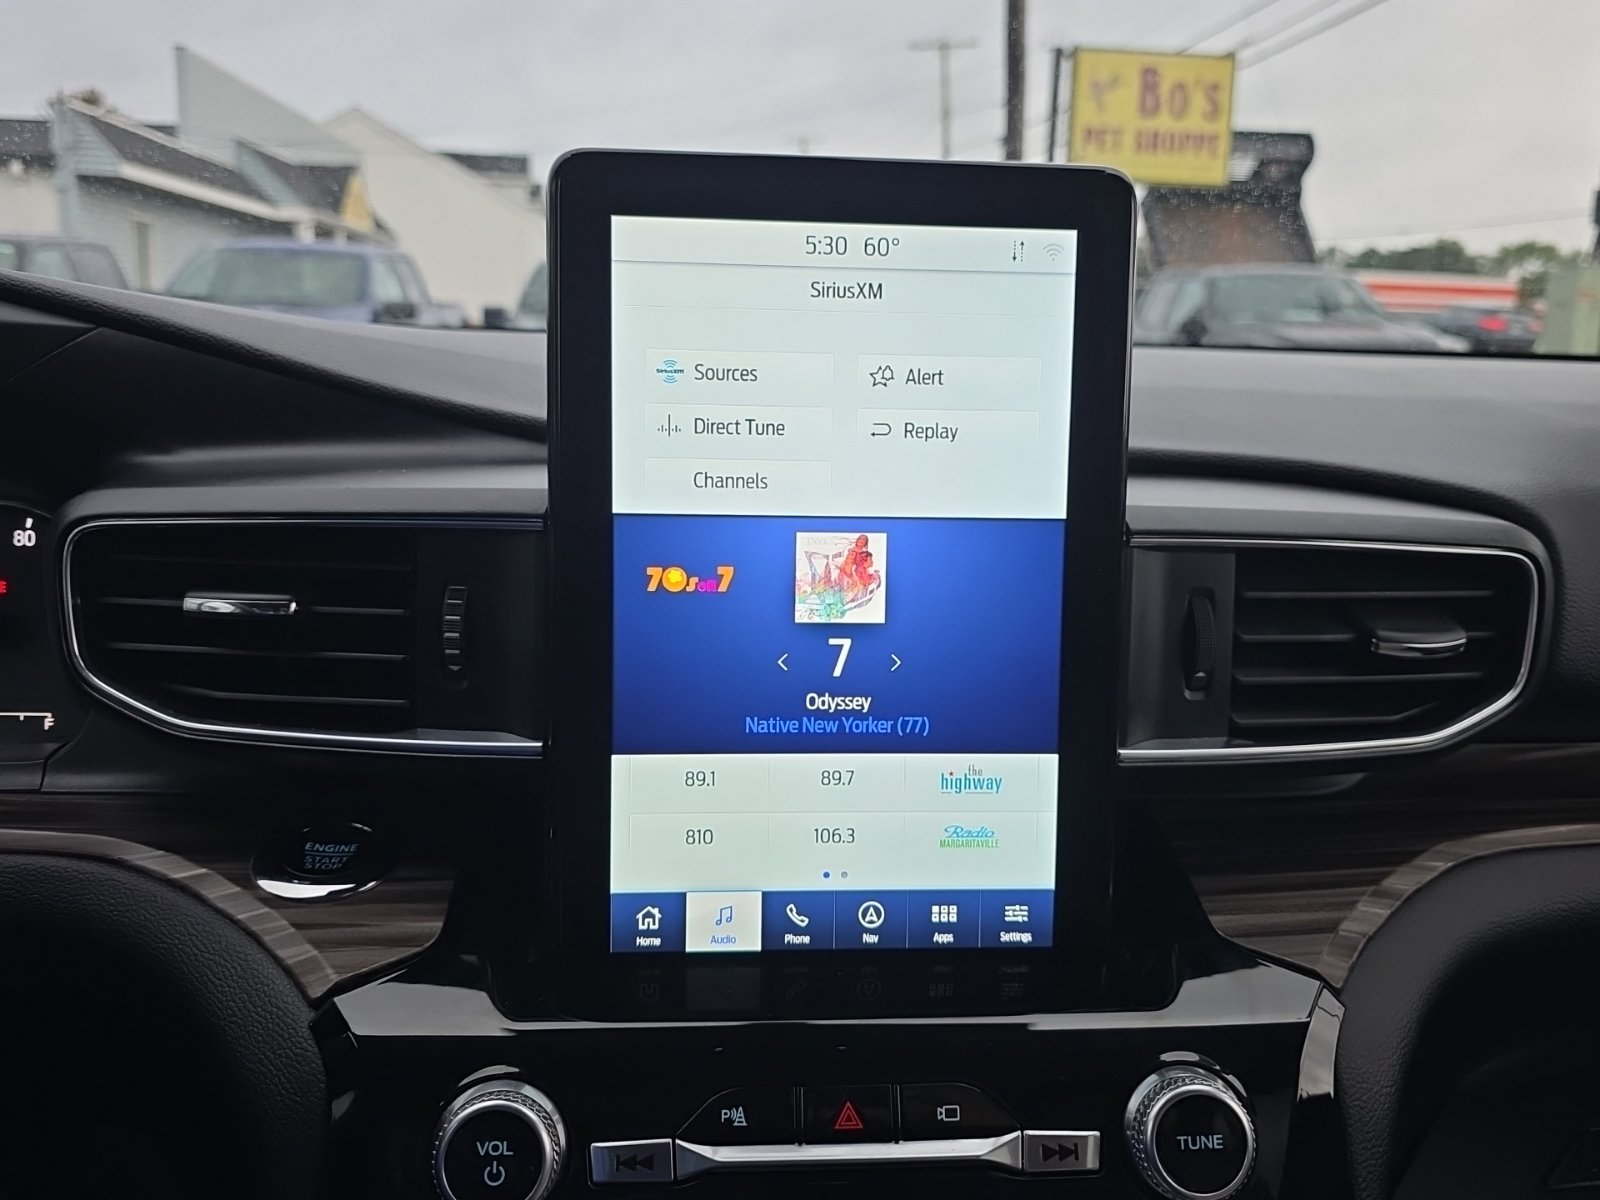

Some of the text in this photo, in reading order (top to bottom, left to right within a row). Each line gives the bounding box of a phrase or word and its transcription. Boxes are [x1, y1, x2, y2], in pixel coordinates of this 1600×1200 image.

[804, 235, 900, 256] 5:30 60°
[810, 281, 883, 300] SiriusXM
[694, 363, 758, 382] Sources
[905, 368, 944, 386] Alert
[693, 418, 786, 437] Direct Tune
[904, 422, 959, 442] Replay
[693, 472, 769, 490] Channels
[13, 530, 36, 547] 80
[828, 637, 853, 677] 7
[805, 692, 872, 713] Odyssey
[44, 718, 55, 730] F
[745, 716, 930, 736] Native New Yorker (77)
[820, 770, 855, 786] 89.7
[968, 764, 983, 777] the
[685, 771, 716, 787] 89.1
[940, 771, 1002, 794] highway
[685, 828, 714, 845] 810
[813, 827, 856, 844] 106.3
[944, 825, 995, 839] Radio
[304, 842, 360, 852] ENGINE
[939, 838, 1000, 849] MARGARITAVILLE
[304, 855, 349, 863] START
[636, 936, 661, 947] Home
[710, 934, 737, 945] Audio
[784, 933, 811, 945] Phone
[862, 933, 879, 944] Nav
[933, 932, 954, 943] Apps
[1000, 931, 1032, 943] Settings
[476, 1141, 514, 1156] VOL
[1176, 1134, 1224, 1150] TUNE
